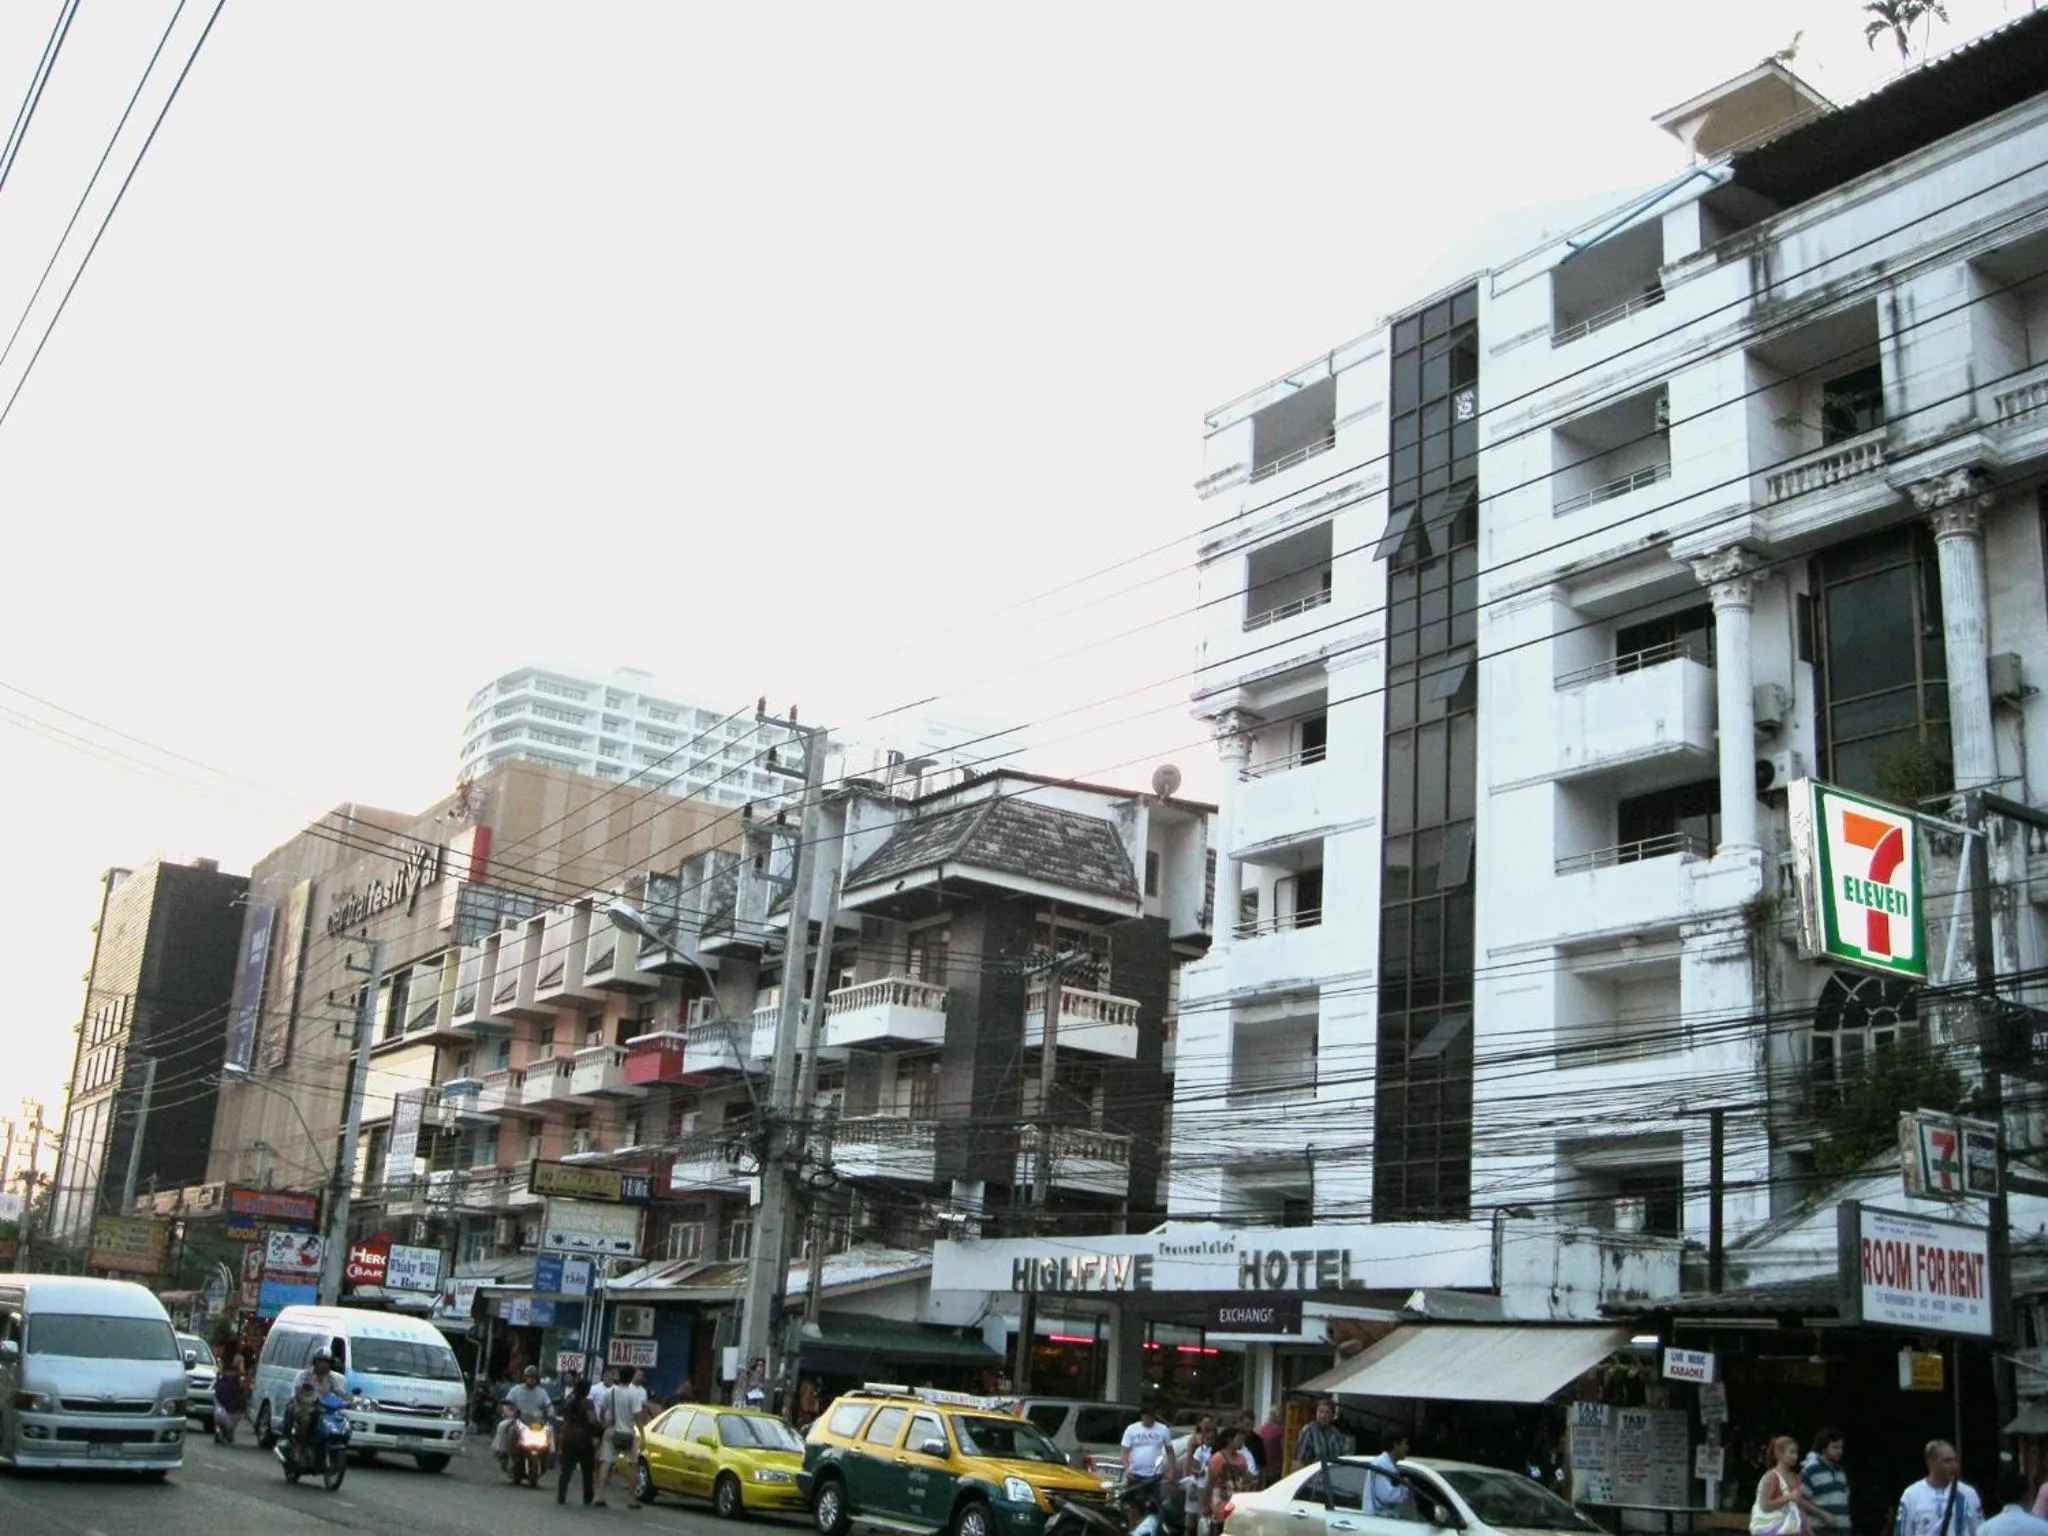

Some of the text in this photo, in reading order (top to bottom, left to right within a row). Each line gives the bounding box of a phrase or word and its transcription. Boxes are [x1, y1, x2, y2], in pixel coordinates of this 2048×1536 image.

[1239, 1249, 1366, 1290] HOTEL
[1862, 1237, 1985, 1299] ROOM FOR RENT
[611, 1341, 632, 1362] TAXI
[1670, 1351, 1685, 1362] LIVE
[1670, 1366, 1704, 1379] KARAOKE
[1578, 1402, 1603, 1416] TAXI
[1622, 1414, 1647, 1424] TAXI
